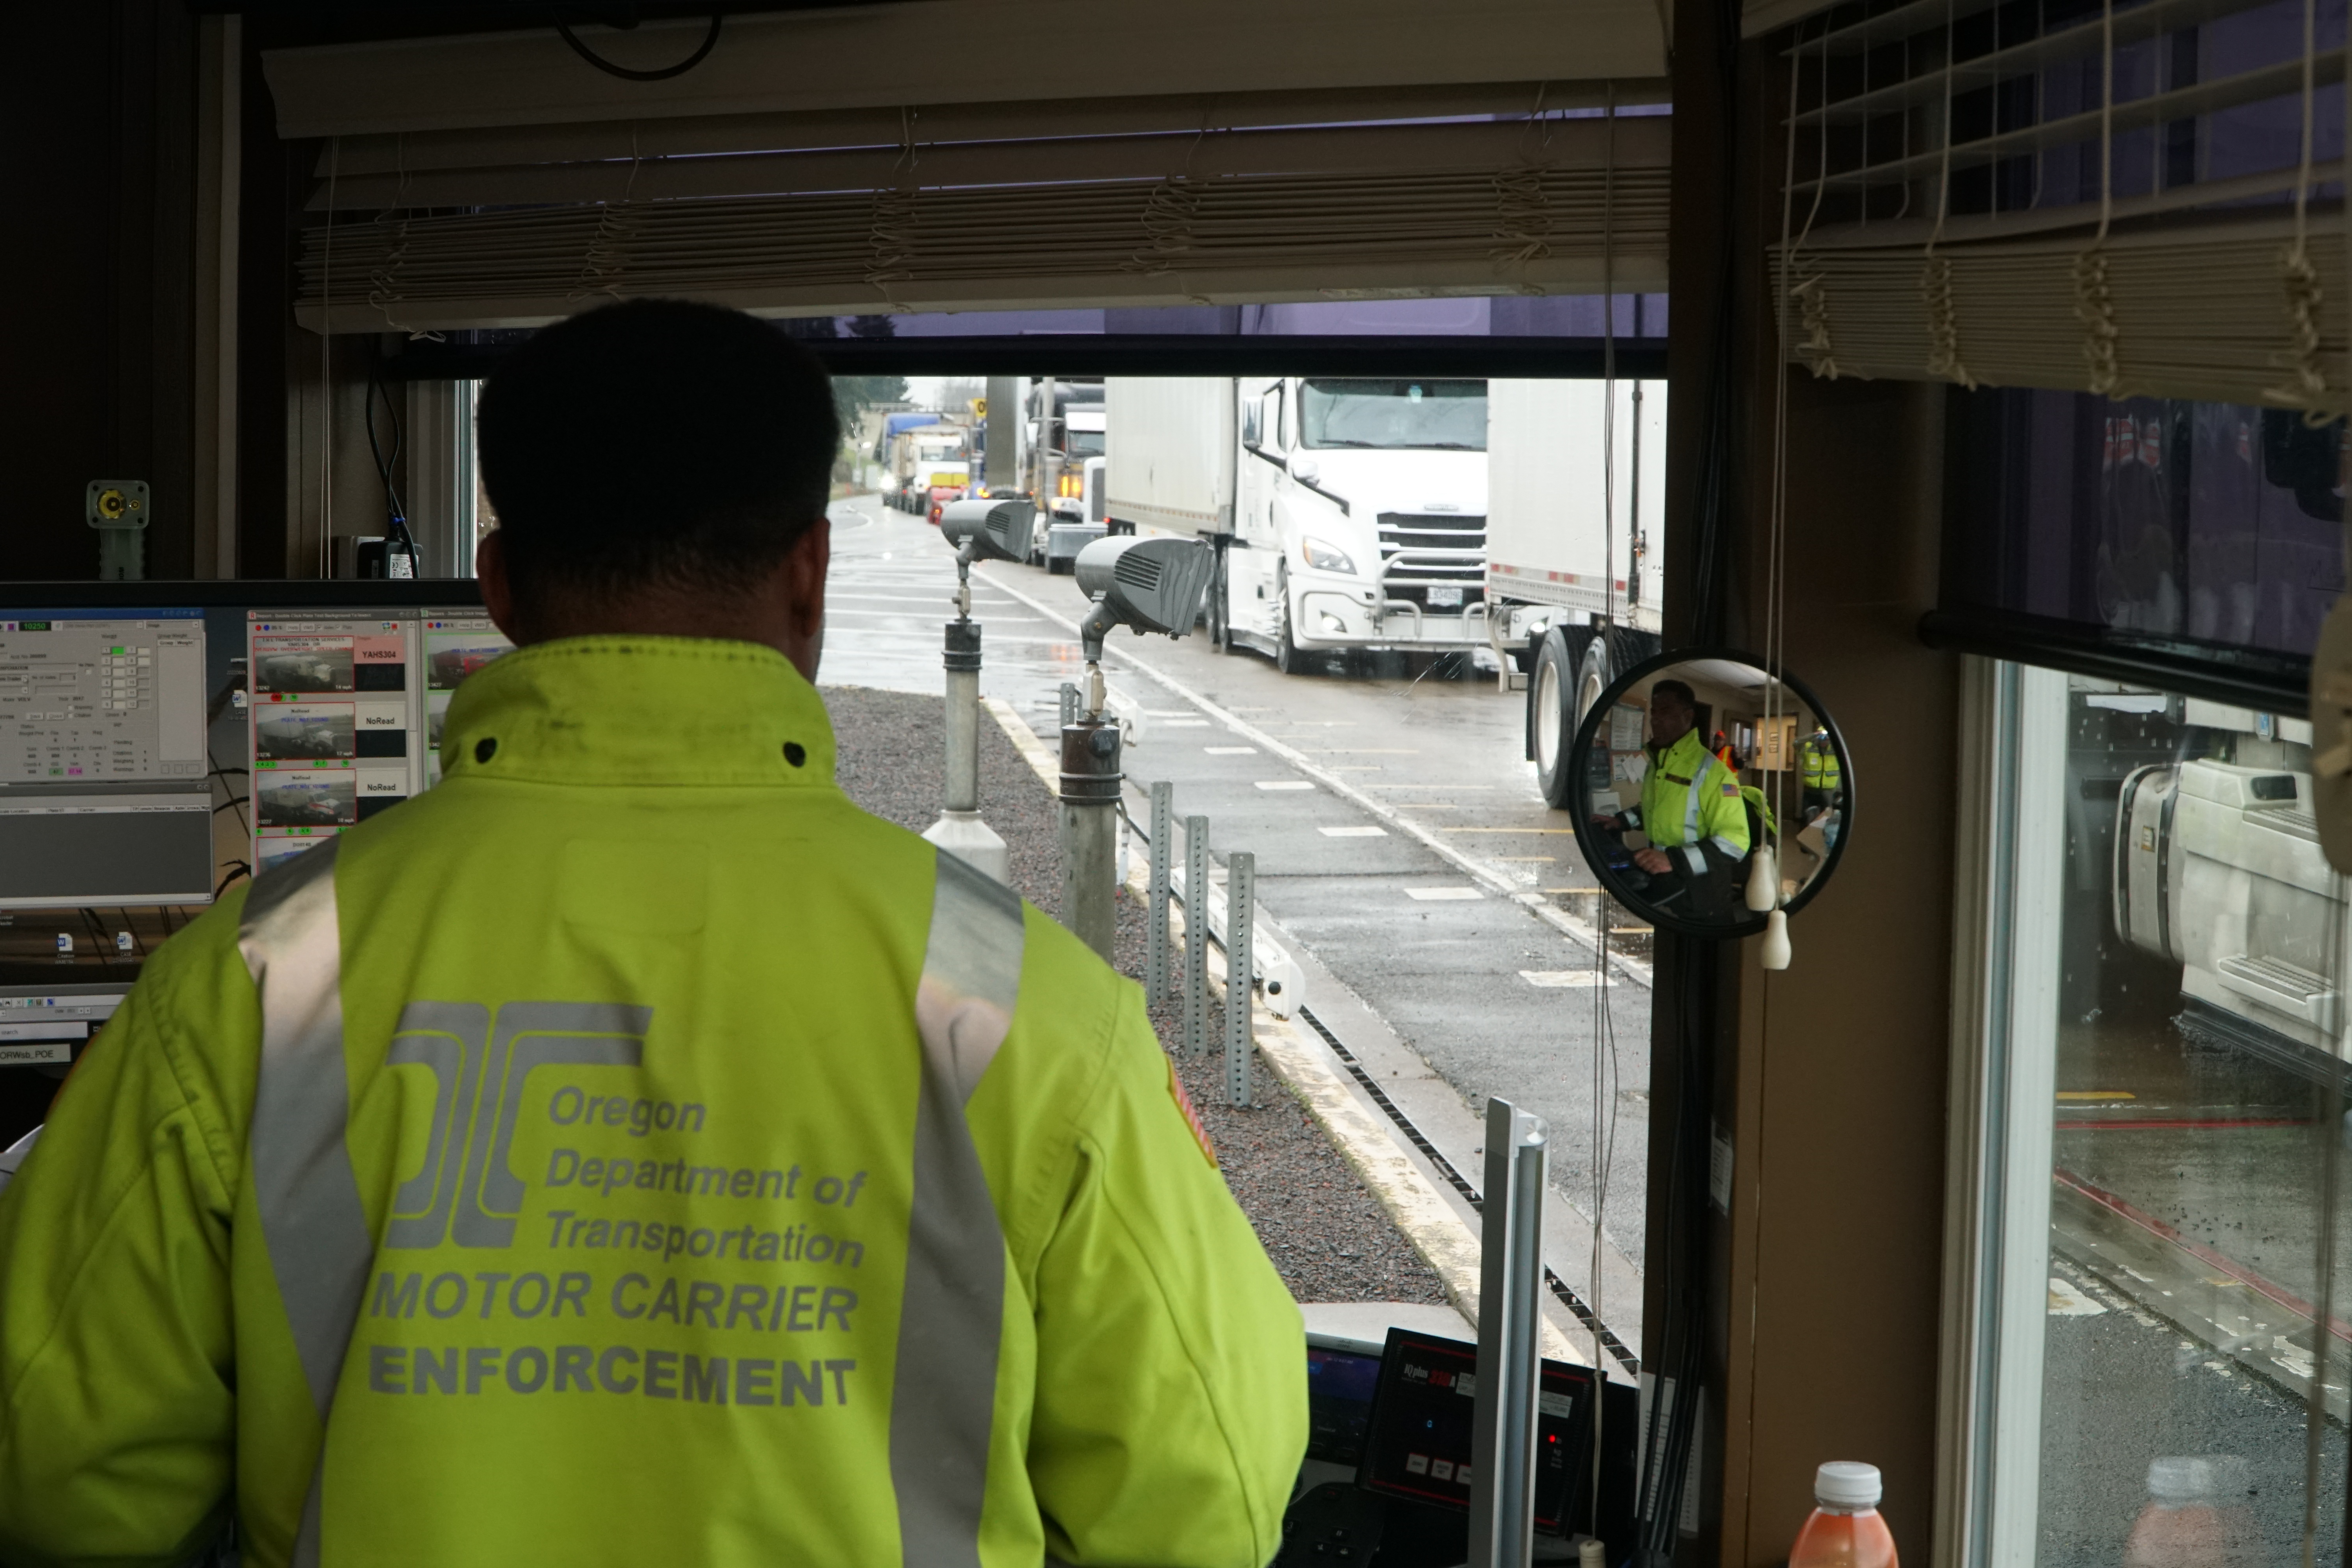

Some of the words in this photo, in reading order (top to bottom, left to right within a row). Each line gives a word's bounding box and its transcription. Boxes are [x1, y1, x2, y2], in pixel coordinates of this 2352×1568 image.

[366, 717, 395, 726] NoRead
[367, 783, 396, 791] NoRead
[549, 1086, 706, 1136] Oregon
[546, 1149, 800, 1200] Department
[813, 1171, 867, 1208] of
[547, 1210, 865, 1268] Transportation
[370, 1272, 593, 1319] MOTOR
[610, 1272, 858, 1332] CARRIER
[369, 1345, 857, 1406] ENFORCEMENT
[1412, 1366, 1429, 1379] plus
